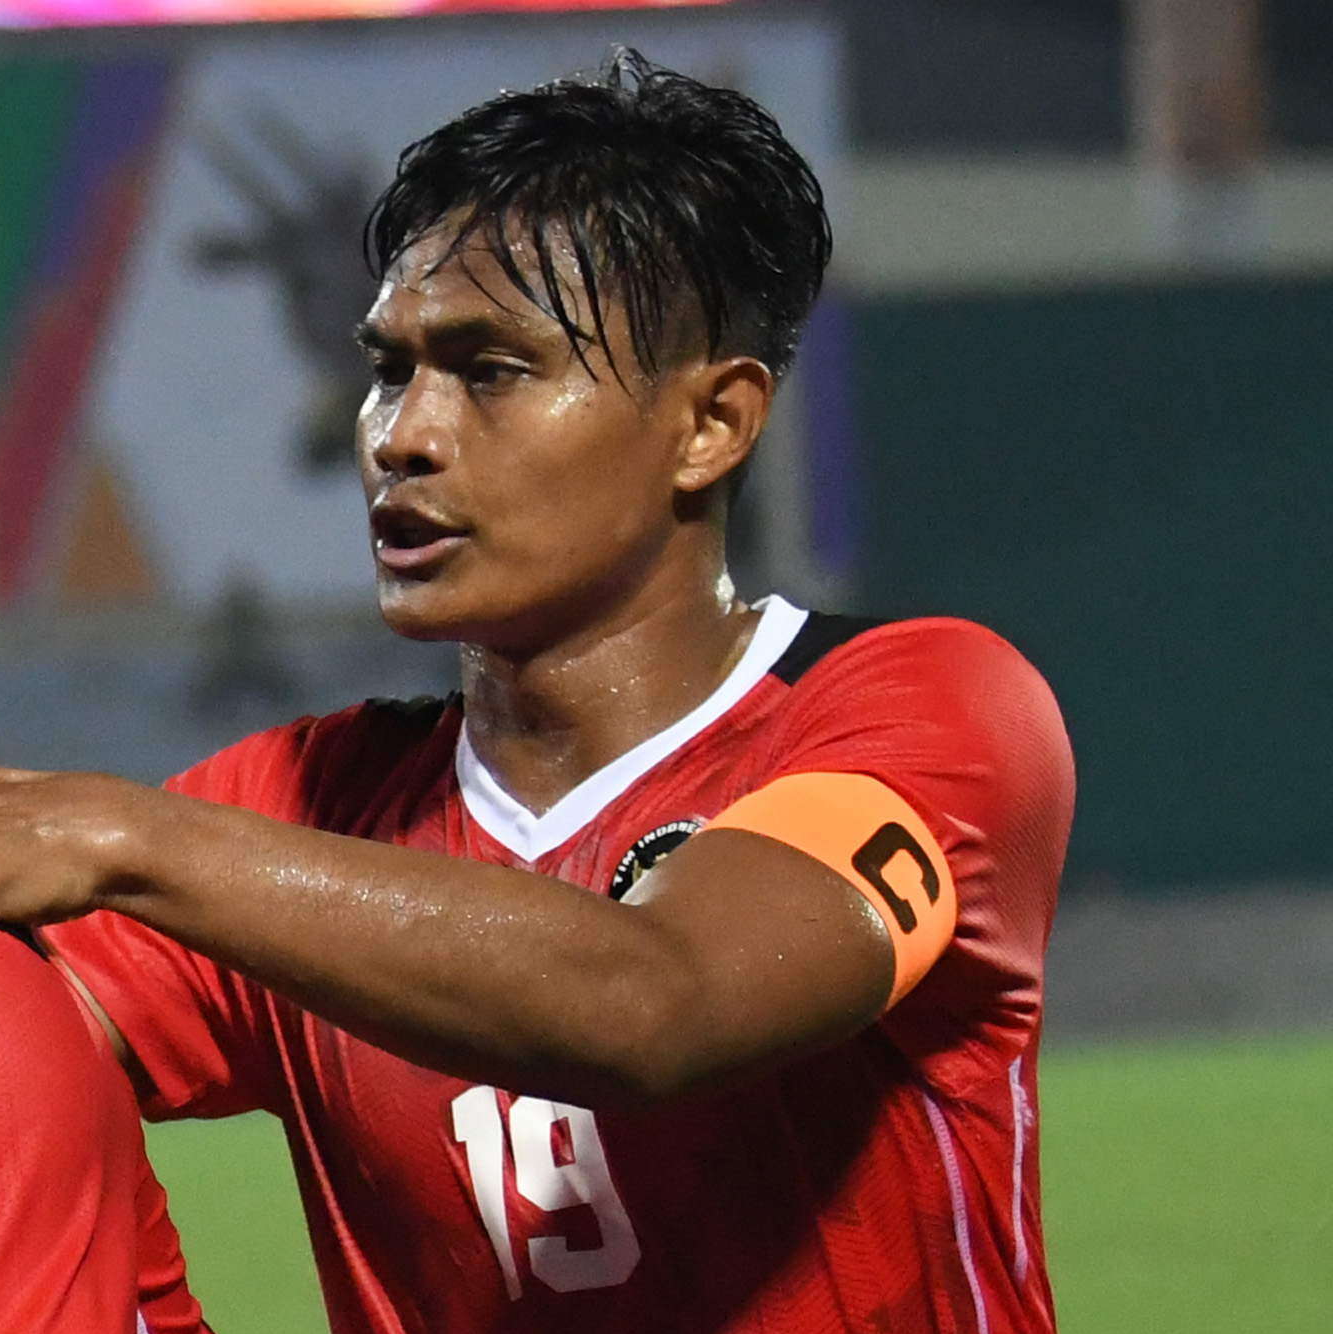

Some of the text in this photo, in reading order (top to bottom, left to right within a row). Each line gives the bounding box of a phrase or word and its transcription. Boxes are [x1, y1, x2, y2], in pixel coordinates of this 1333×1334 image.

[613, 821, 701, 887] TIM INDONE
[851, 821, 940, 934] C
[451, 1084, 641, 1300] 19
